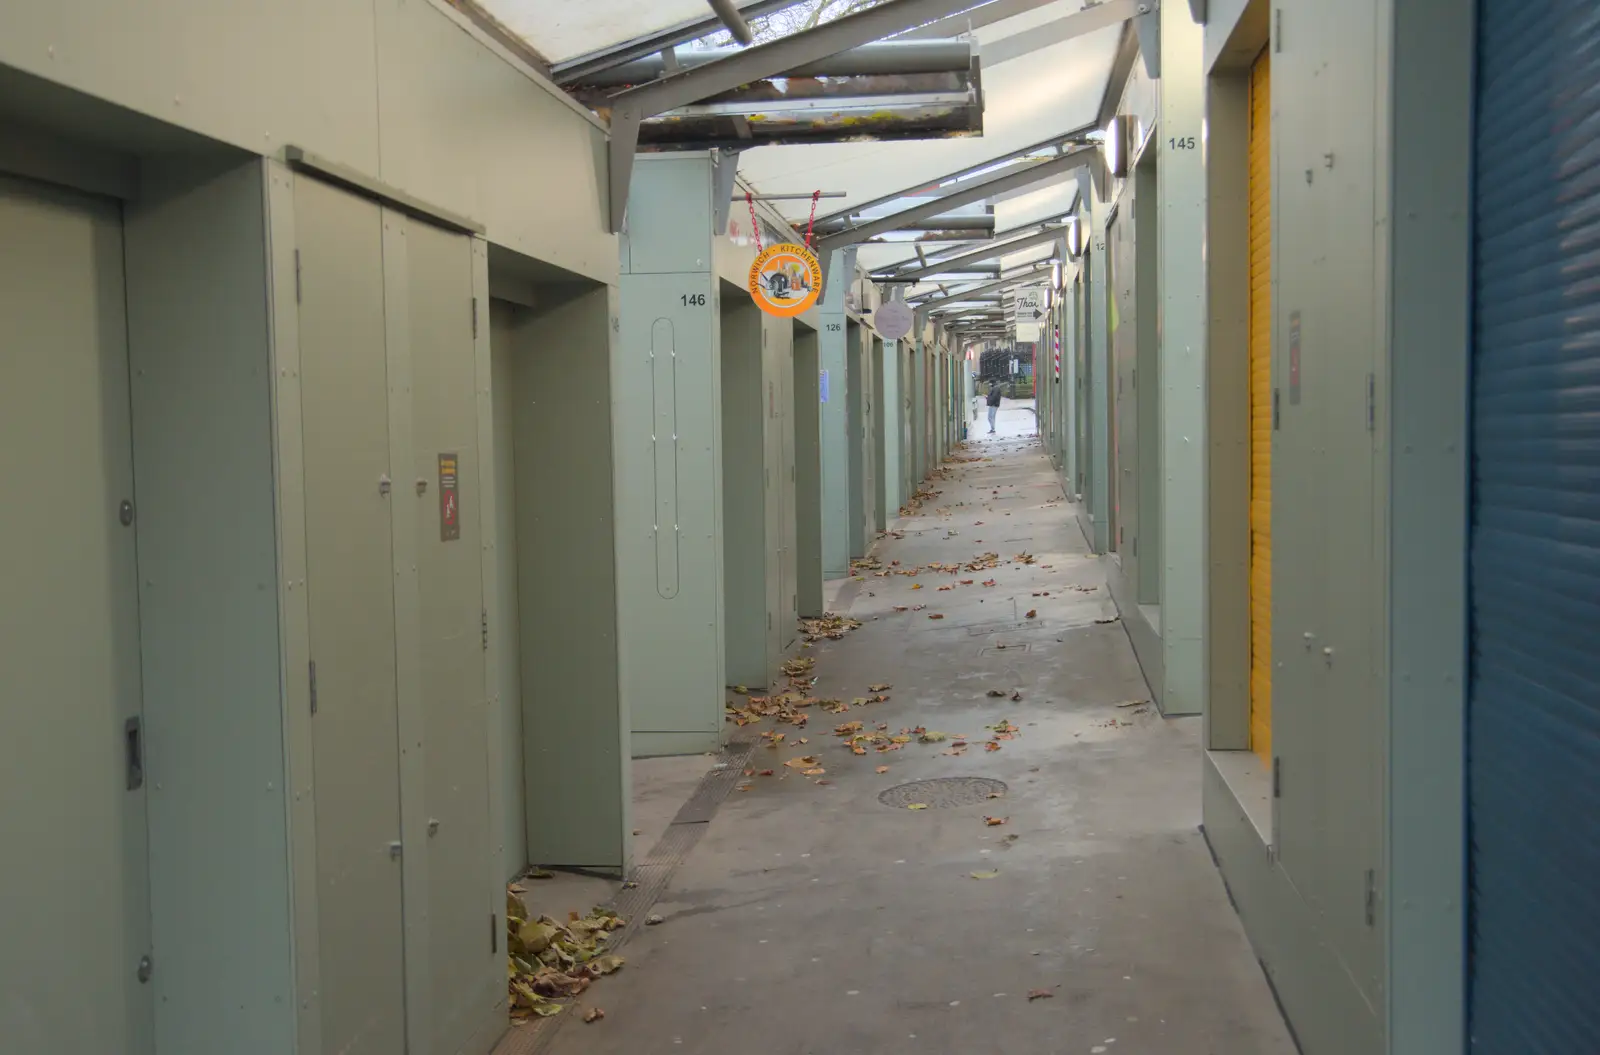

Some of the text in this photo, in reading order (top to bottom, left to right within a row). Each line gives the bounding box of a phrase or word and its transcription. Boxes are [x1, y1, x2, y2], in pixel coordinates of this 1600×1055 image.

[1169, 137, 1195, 150] 145
[1096, 242, 1105, 251] 12
[752, 245, 820, 294] NORWICH KITCHENWARE
[680, 294, 706, 306] 146
[1016, 297, 1039, 309] Thai
[826, 323, 841, 331] 126
